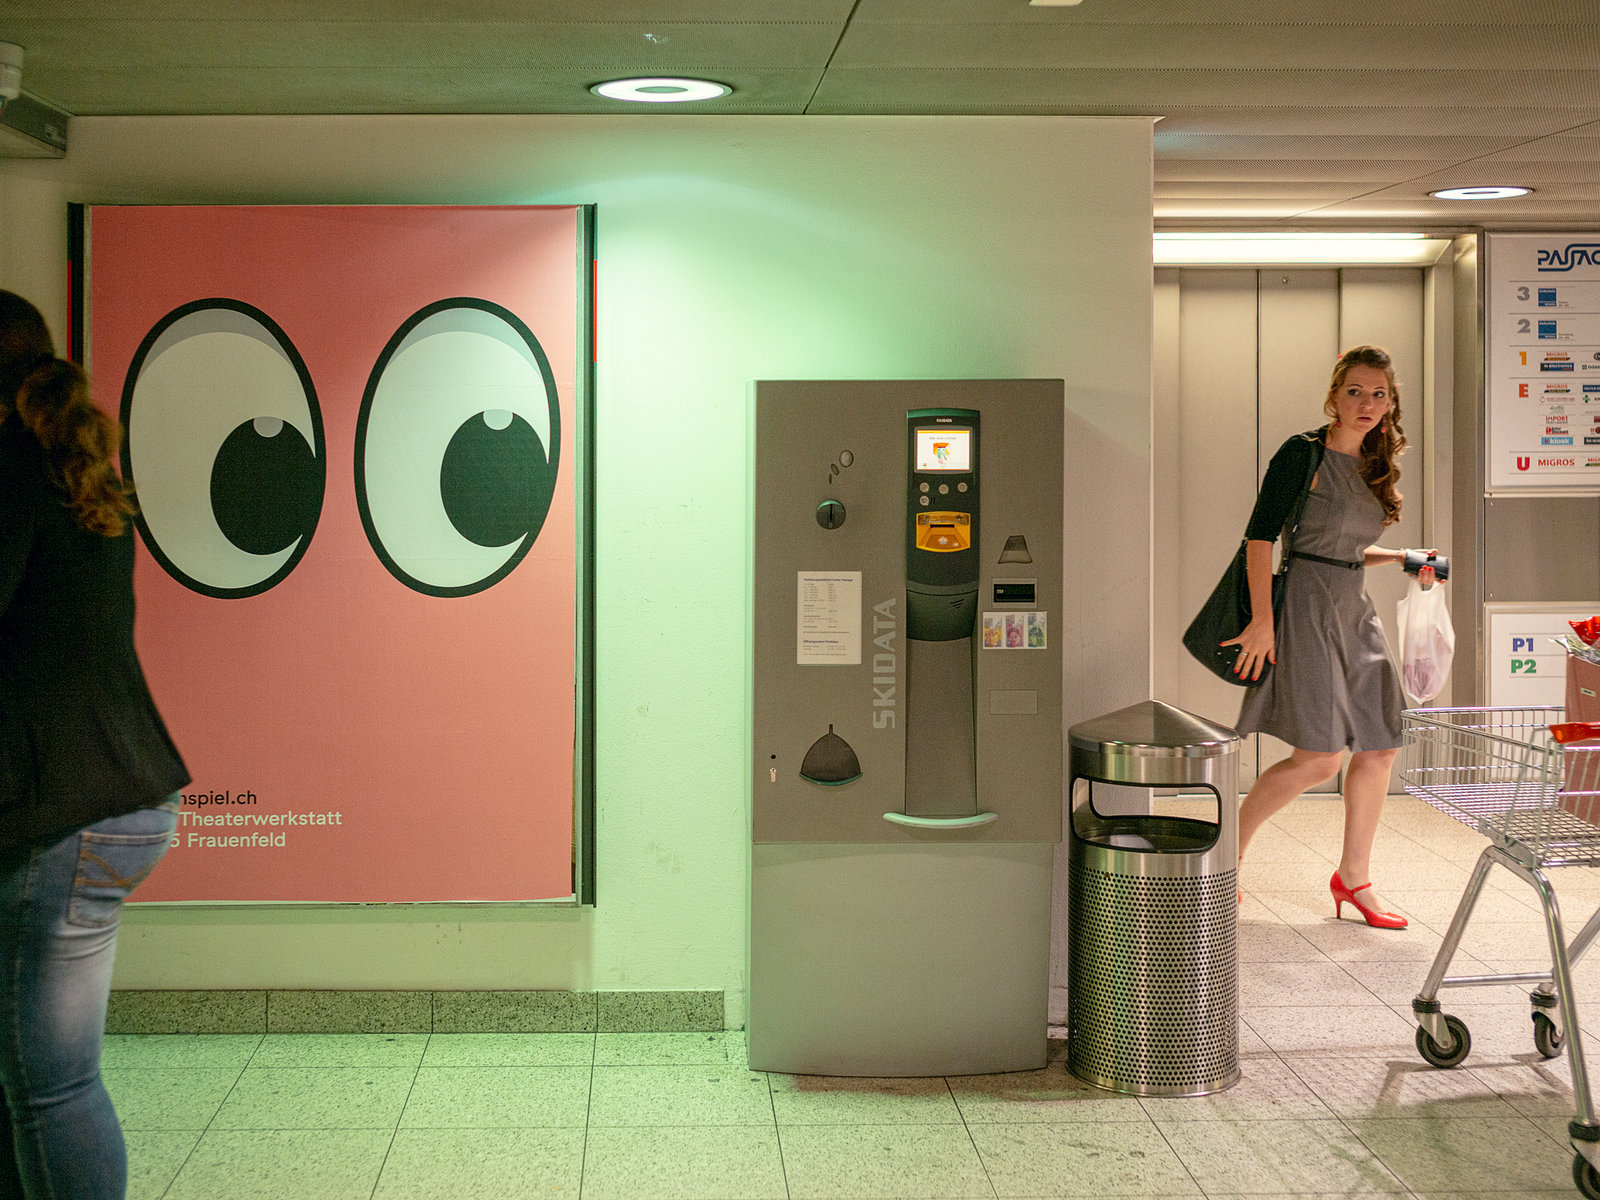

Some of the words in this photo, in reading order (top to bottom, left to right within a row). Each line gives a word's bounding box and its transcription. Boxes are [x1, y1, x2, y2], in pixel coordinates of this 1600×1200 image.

[1517, 286, 1530, 301] 3
[1517, 318, 1531, 334] 2
[1519, 351, 1527, 366] 1
[1519, 383, 1529, 398] E
[1516, 456, 1530, 471] U
[1537, 458, 1575, 467] MIGROS
[1512, 637, 1534, 652] P1
[873, 598, 896, 729] SKIDATA
[1510, 658, 1537, 674] P2
[178, 811, 342, 827] Theaterwerkstatt
[187, 832, 286, 848] Frauenfeld
